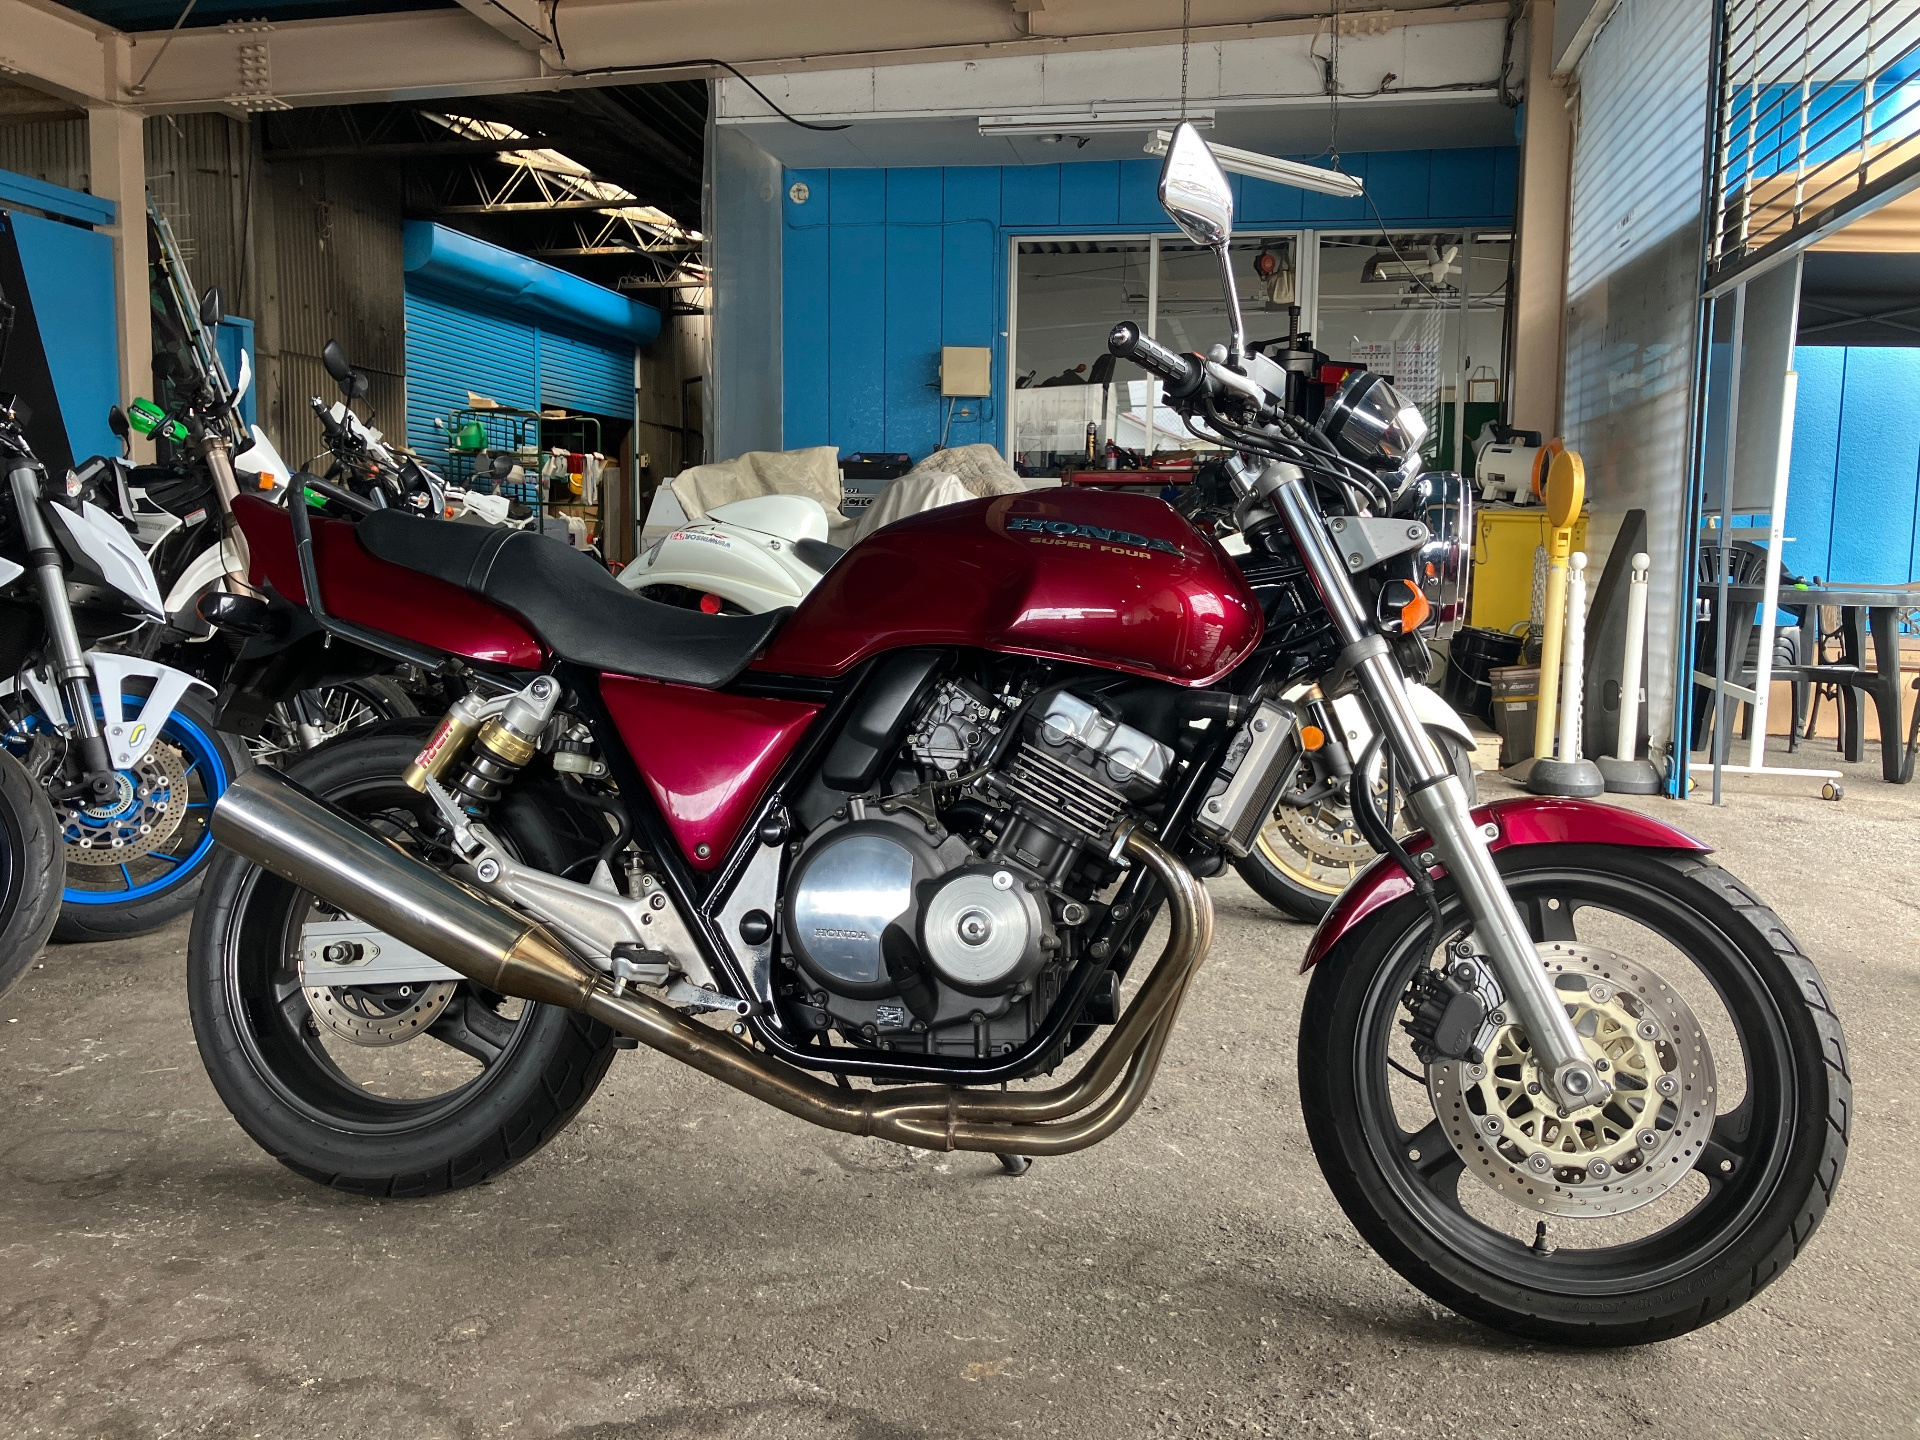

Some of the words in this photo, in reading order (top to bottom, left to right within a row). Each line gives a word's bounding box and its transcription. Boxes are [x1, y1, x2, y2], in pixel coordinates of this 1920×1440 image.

[685, 533, 731, 549] YOSHIMURA
[1006, 517, 1186, 559] HONDA
[1029, 537, 1091, 550] SUPER
[1100, 545, 1151, 560] FOUR
[814, 928, 871, 941] HONDA
